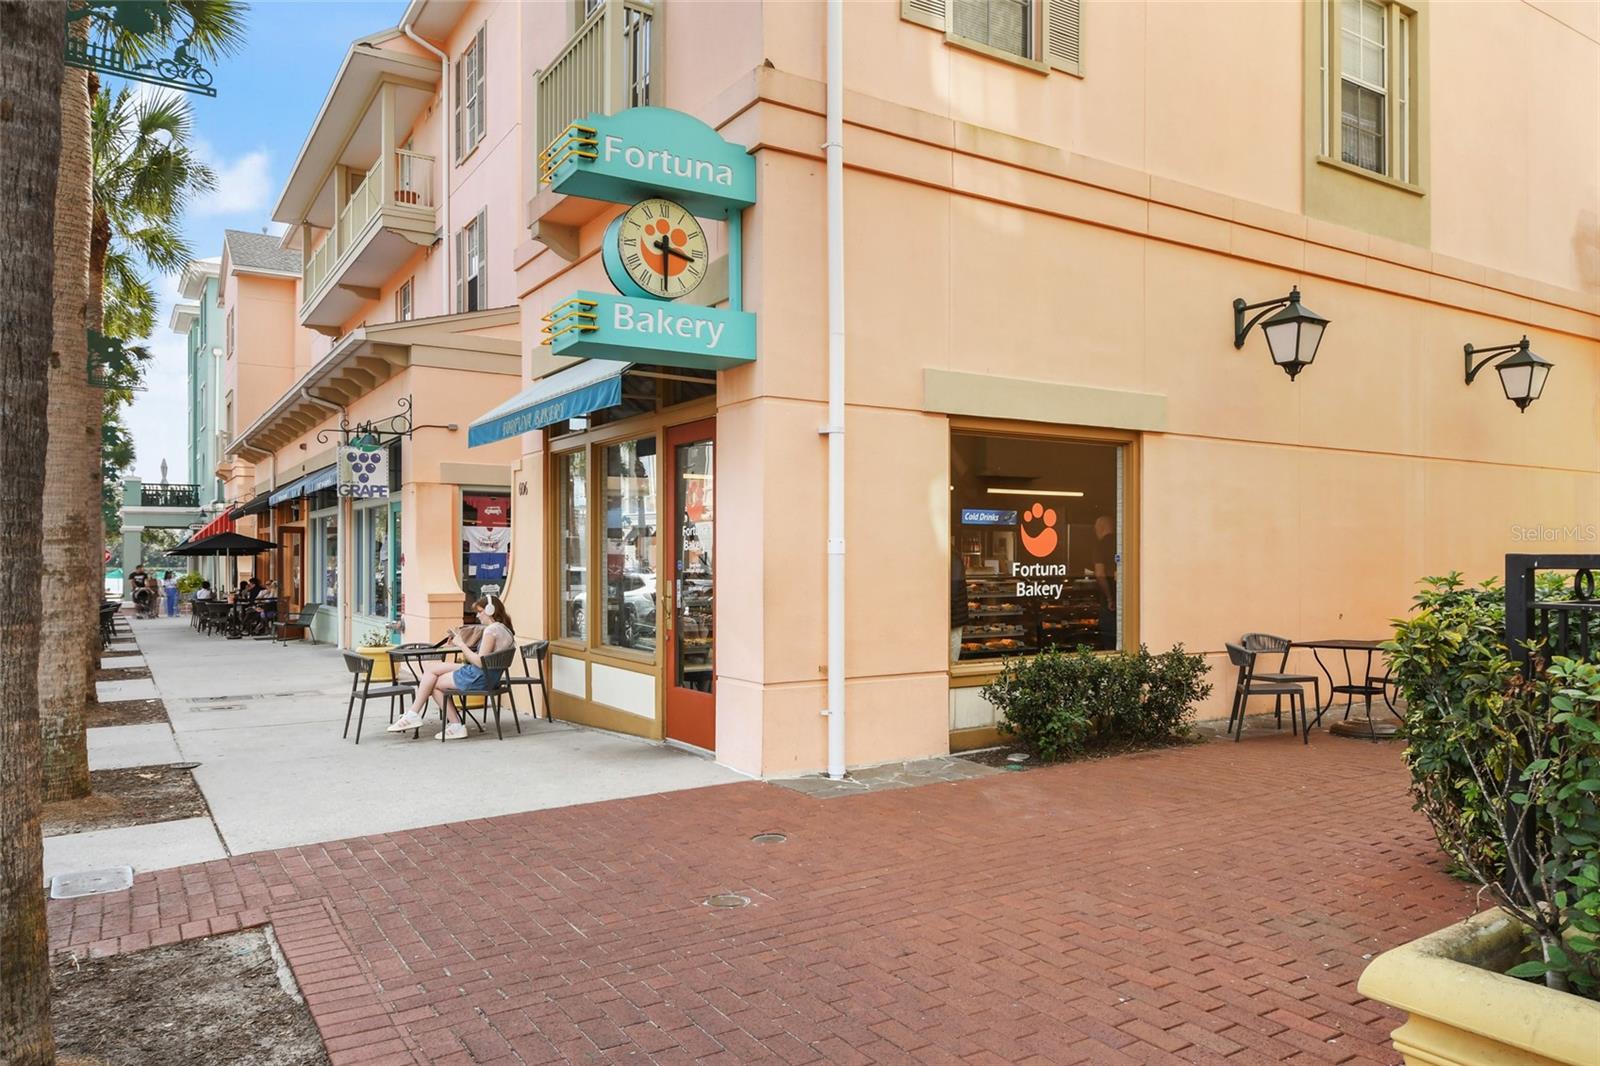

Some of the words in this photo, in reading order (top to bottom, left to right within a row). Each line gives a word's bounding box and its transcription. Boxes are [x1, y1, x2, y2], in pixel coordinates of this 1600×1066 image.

[604, 135, 734, 186] Fortuna
[613, 303, 725, 349] Bakery
[339, 484, 388, 498] GRAPE
[964, 512, 979, 521] Cold
[980, 512, 999, 521] Drinks
[1012, 562, 1066, 577] Fortuna
[1016, 582, 1064, 600] Bakery
